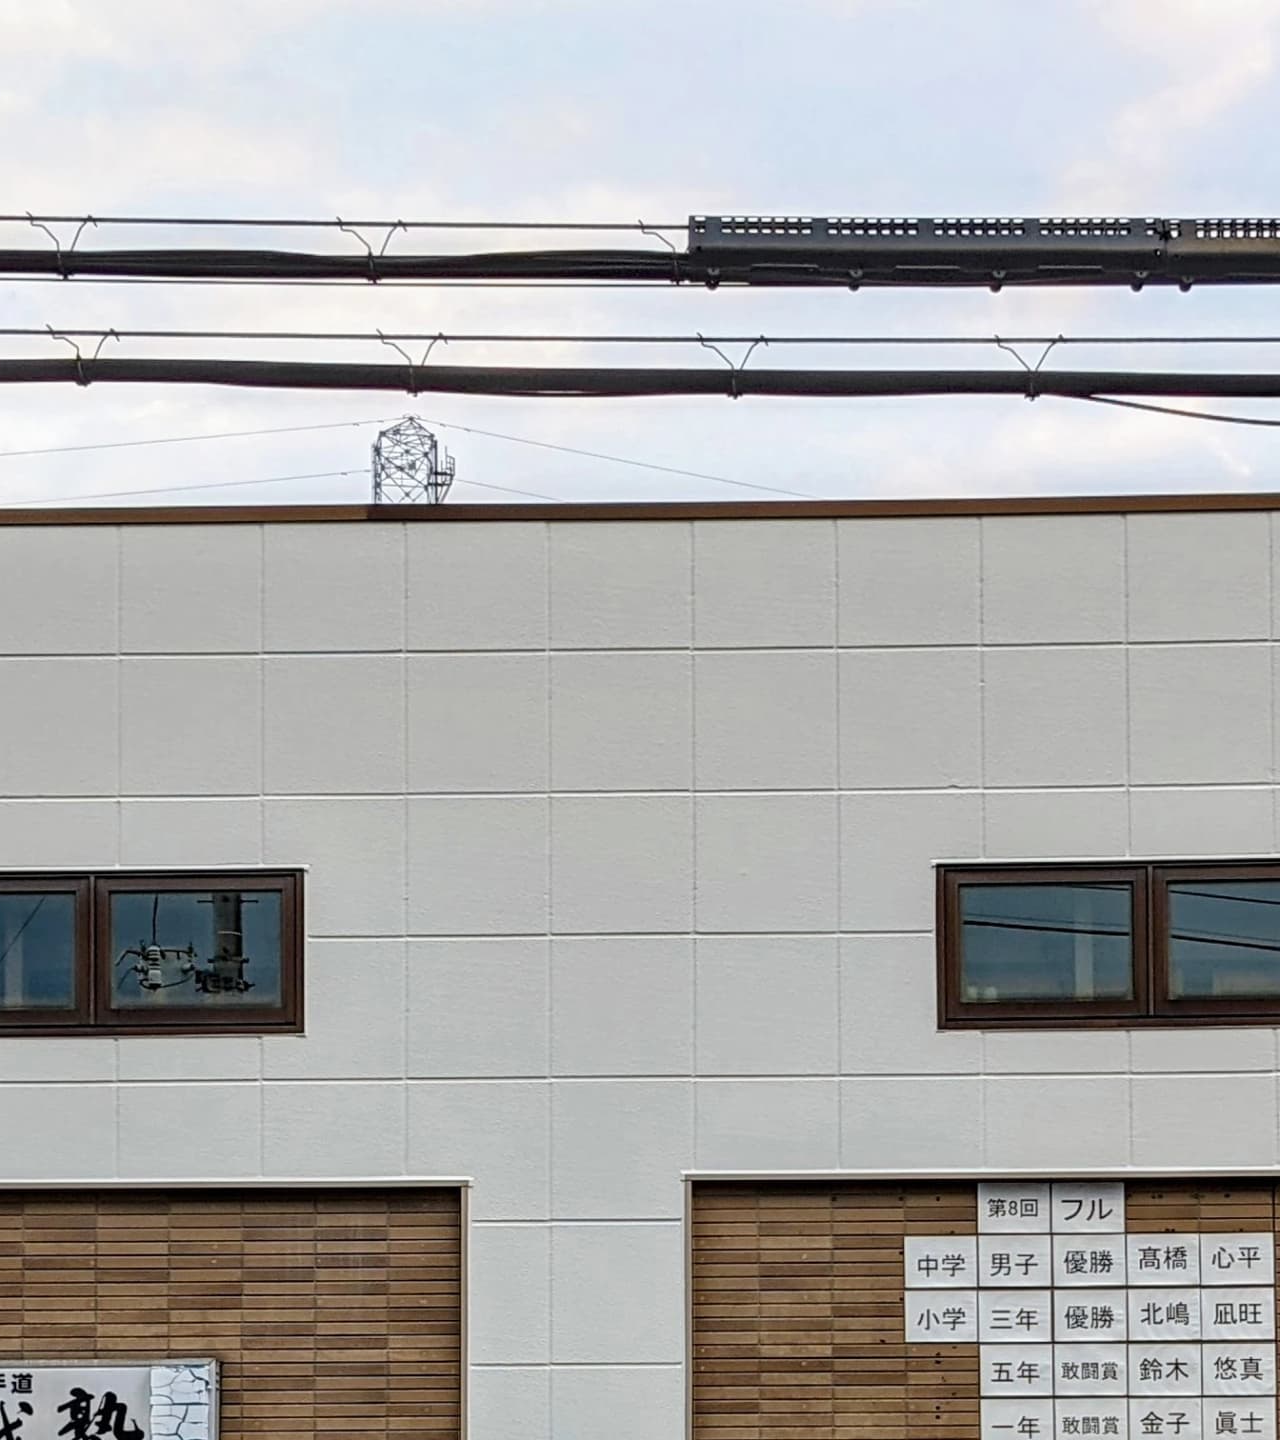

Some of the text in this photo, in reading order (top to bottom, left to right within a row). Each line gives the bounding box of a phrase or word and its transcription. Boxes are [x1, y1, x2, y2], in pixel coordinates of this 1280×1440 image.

[987, 1197, 1113, 1221] 第8回 フル
[917, 1254, 966, 1277] 中学
[990, 1253, 1039, 1277] 男子
[1064, 1250, 1114, 1274] 優勝
[1212, 1247, 1261, 1270] 心平
[917, 1302, 1263, 1331] 小学 三年 優勝 北嶋 凪旺
[991, 1357, 1263, 1384] 五年 敢闘賞 鈴木 悠真
[991, 1411, 1264, 1439] 一年 敢闘賞 金子 眞士
